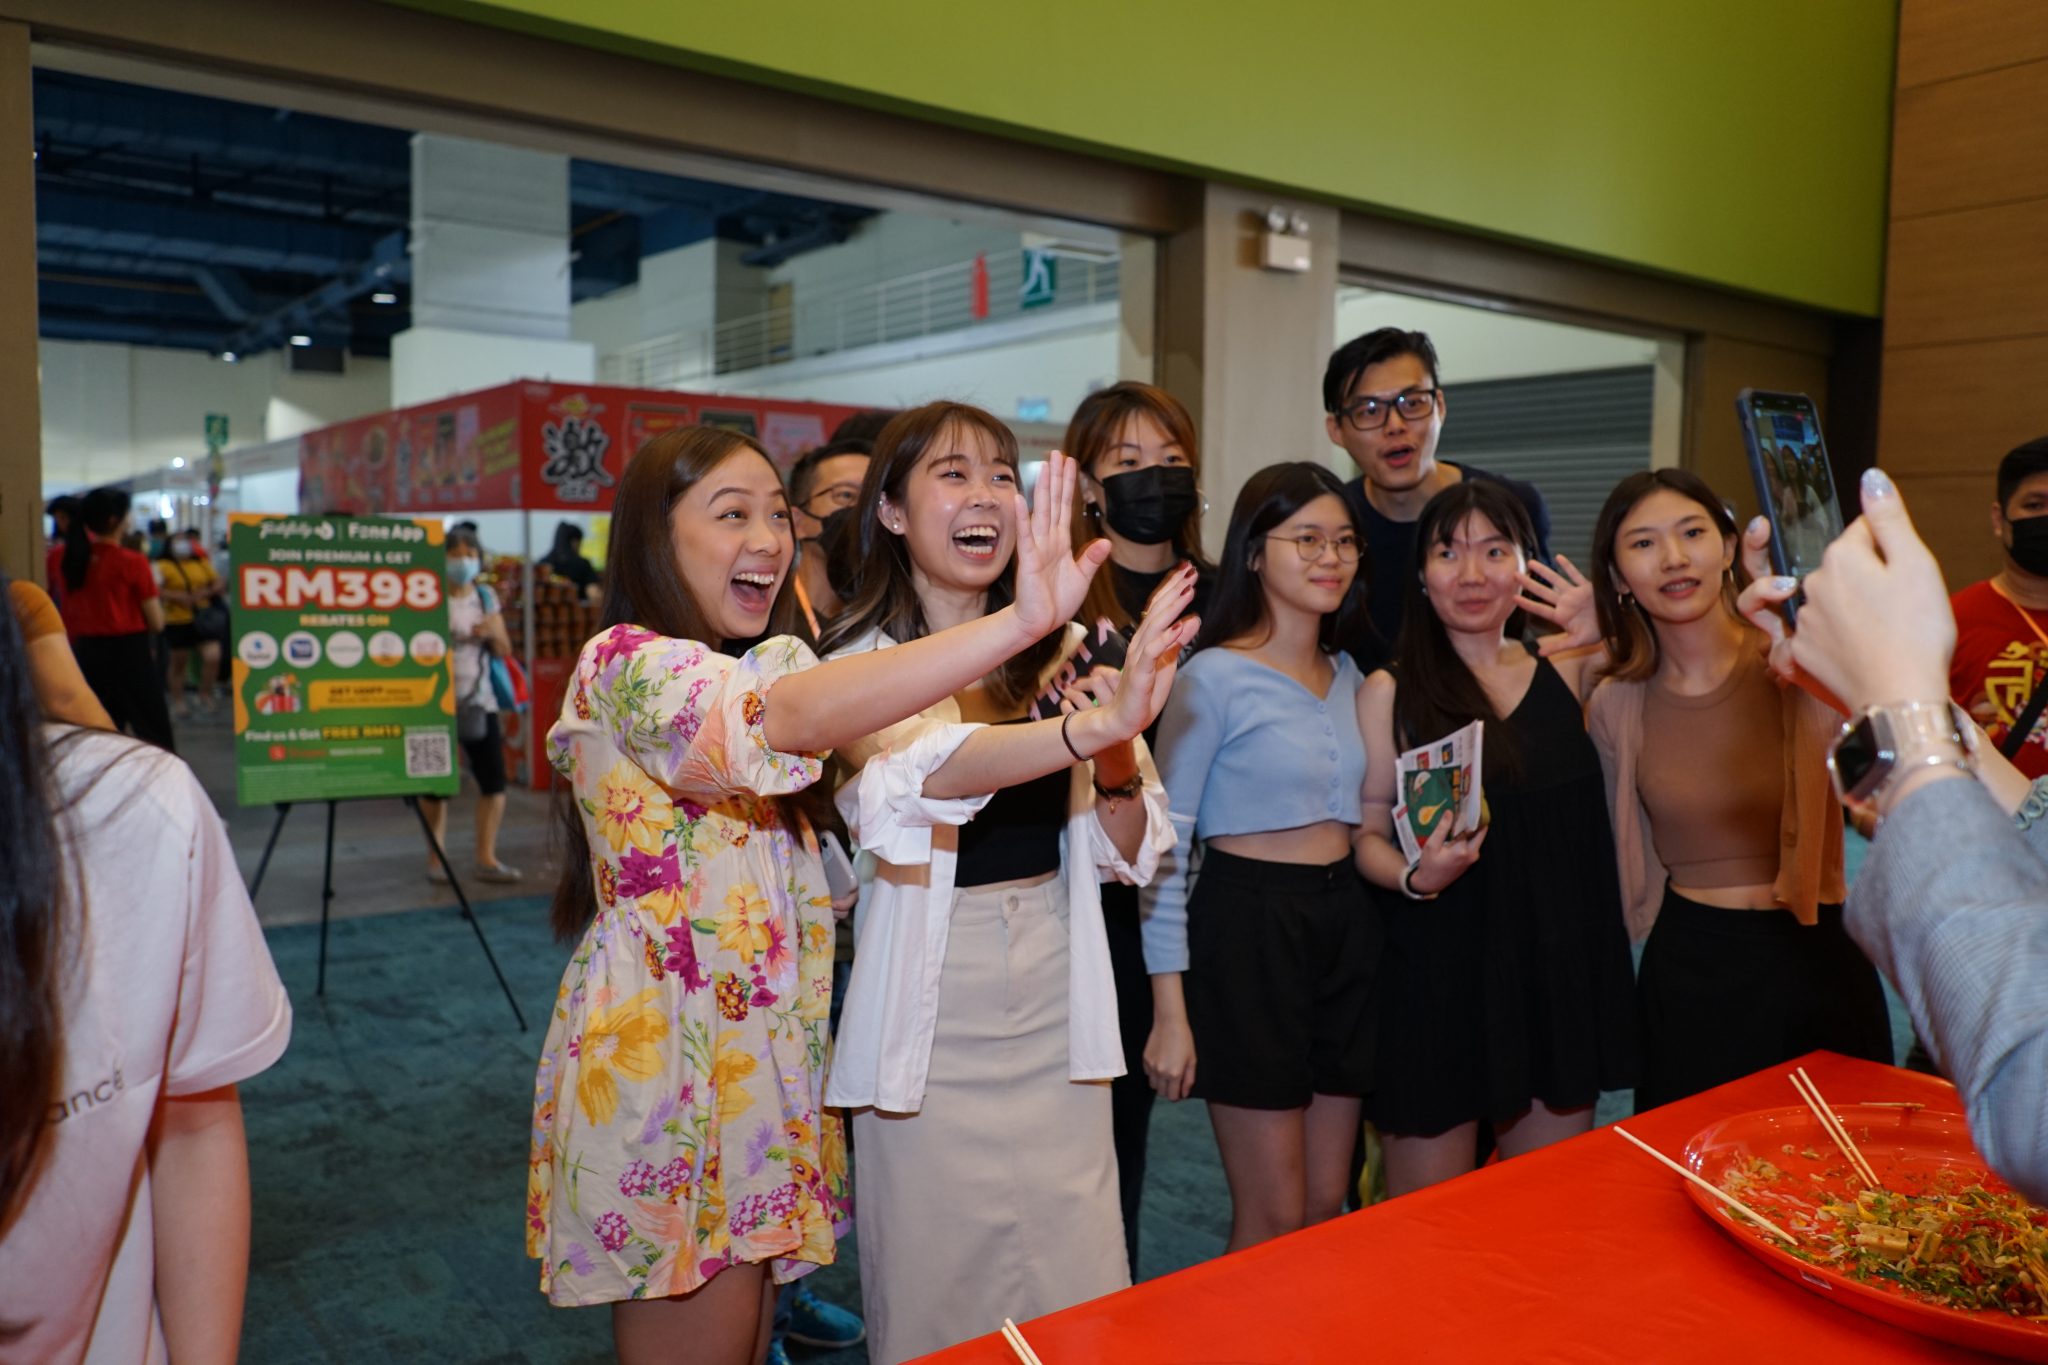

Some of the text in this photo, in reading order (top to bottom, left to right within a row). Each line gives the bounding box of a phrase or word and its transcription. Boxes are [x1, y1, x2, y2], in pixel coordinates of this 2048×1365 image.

[391, 523, 424, 542] App
[268, 549, 412, 564] JOIN PREMIUM & GET
[243, 566, 441, 609] RM398
[299, 614, 390, 627] REBATES ON
[322, 726, 359, 740] FREE
